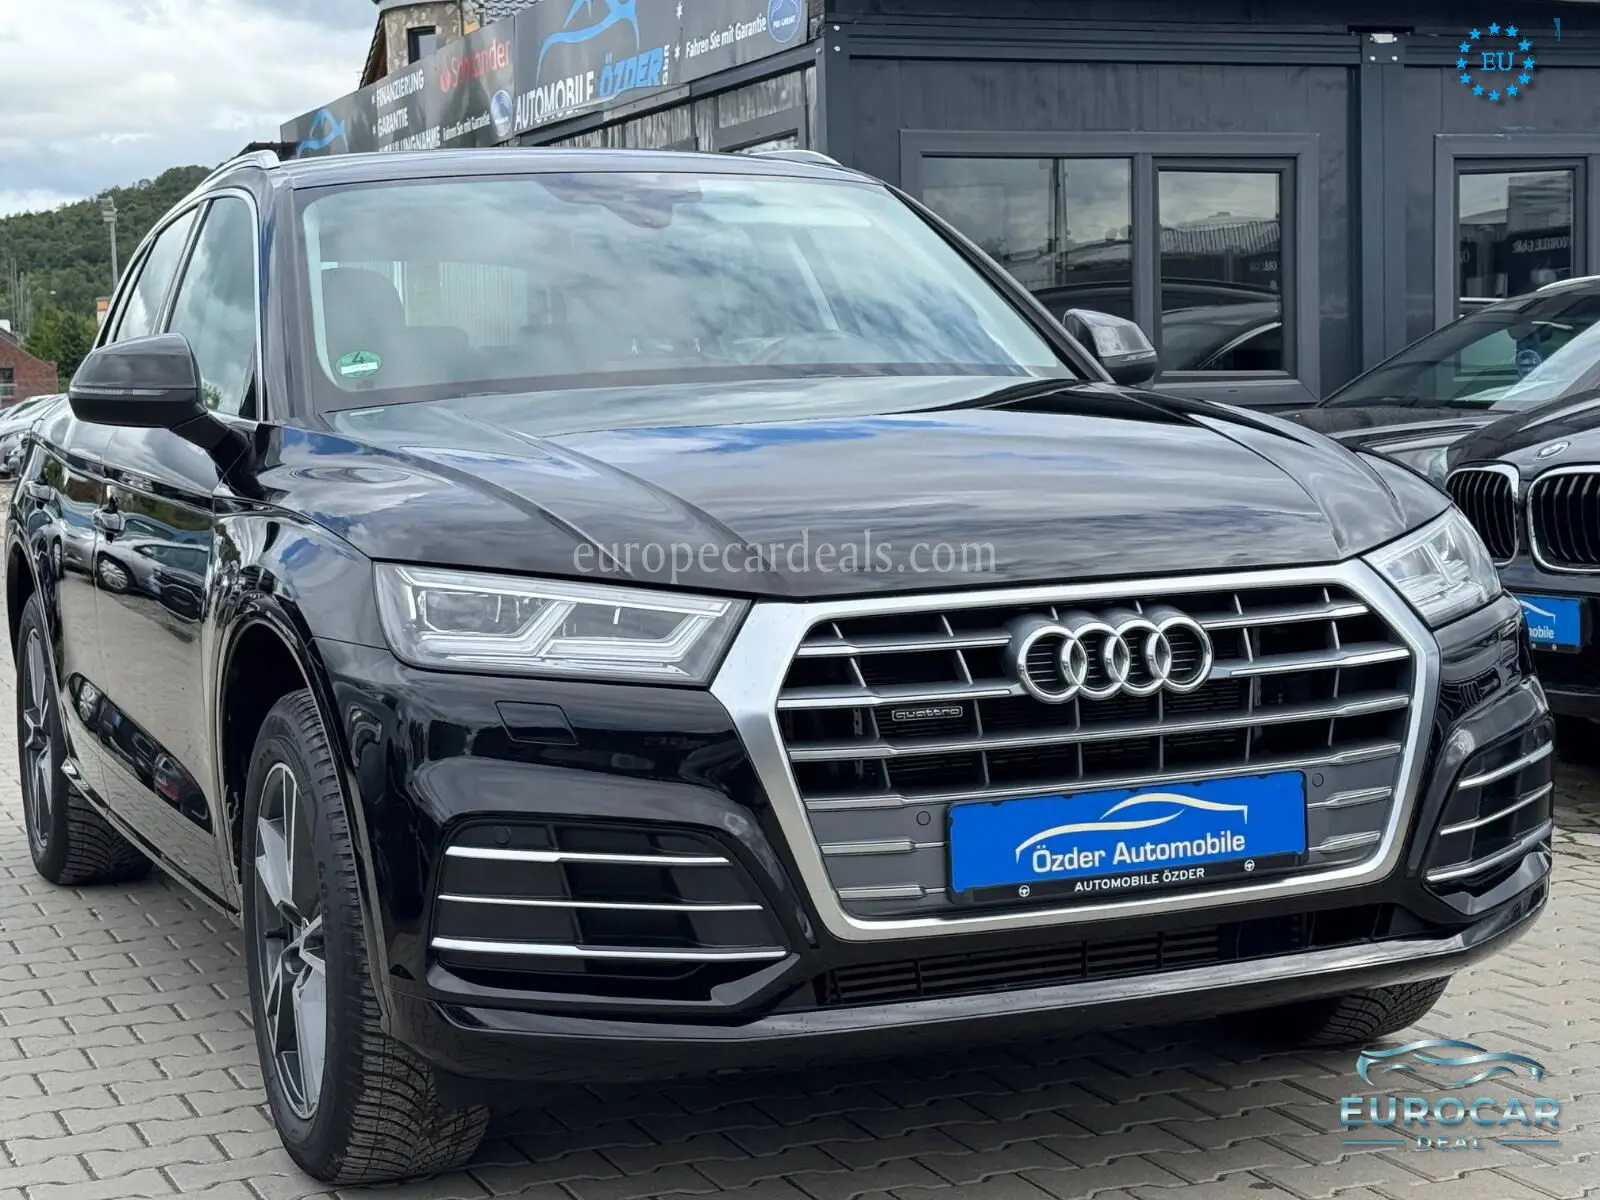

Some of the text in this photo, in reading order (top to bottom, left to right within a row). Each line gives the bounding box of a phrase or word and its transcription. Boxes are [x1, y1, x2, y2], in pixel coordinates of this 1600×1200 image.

[685, 12, 767, 59] Fahren Sie mit Garantie
[376, 68, 425, 109] FINANZIERUNG
[514, 47, 663, 131] AUTOMOBILE ÖZDER
[377, 106, 409, 137] GARANTIE
[895, 707, 960, 719] quattro
[1032, 830, 1246, 874] Özder Automobile
[1074, 866, 1206, 893] AUTOMOBILE ÖZDER
